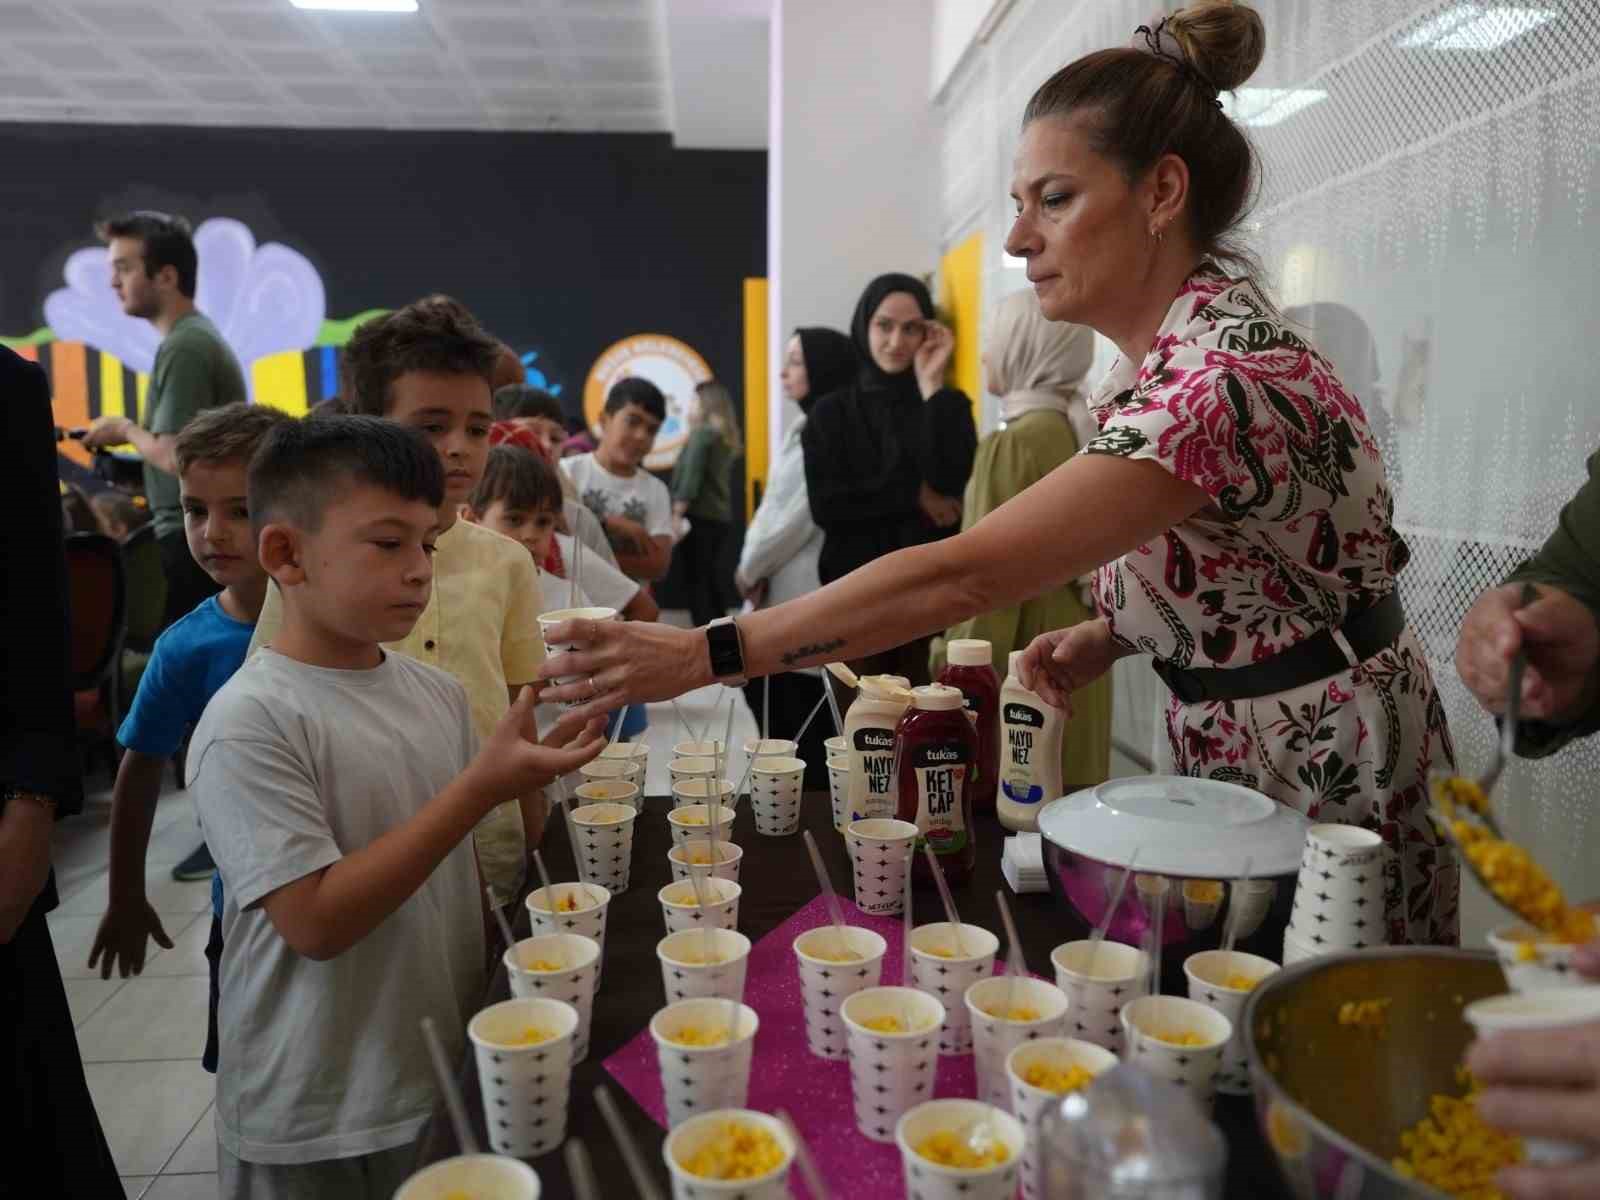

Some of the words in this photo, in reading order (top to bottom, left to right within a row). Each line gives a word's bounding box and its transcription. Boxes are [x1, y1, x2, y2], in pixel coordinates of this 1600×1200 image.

[1009, 729, 1033, 749] MAYO
[1012, 748, 1030, 765] NEZ
[869, 773, 890, 794] NEZ
[926, 768, 953, 793] KET
[928, 791, 955, 817] ÇAP
